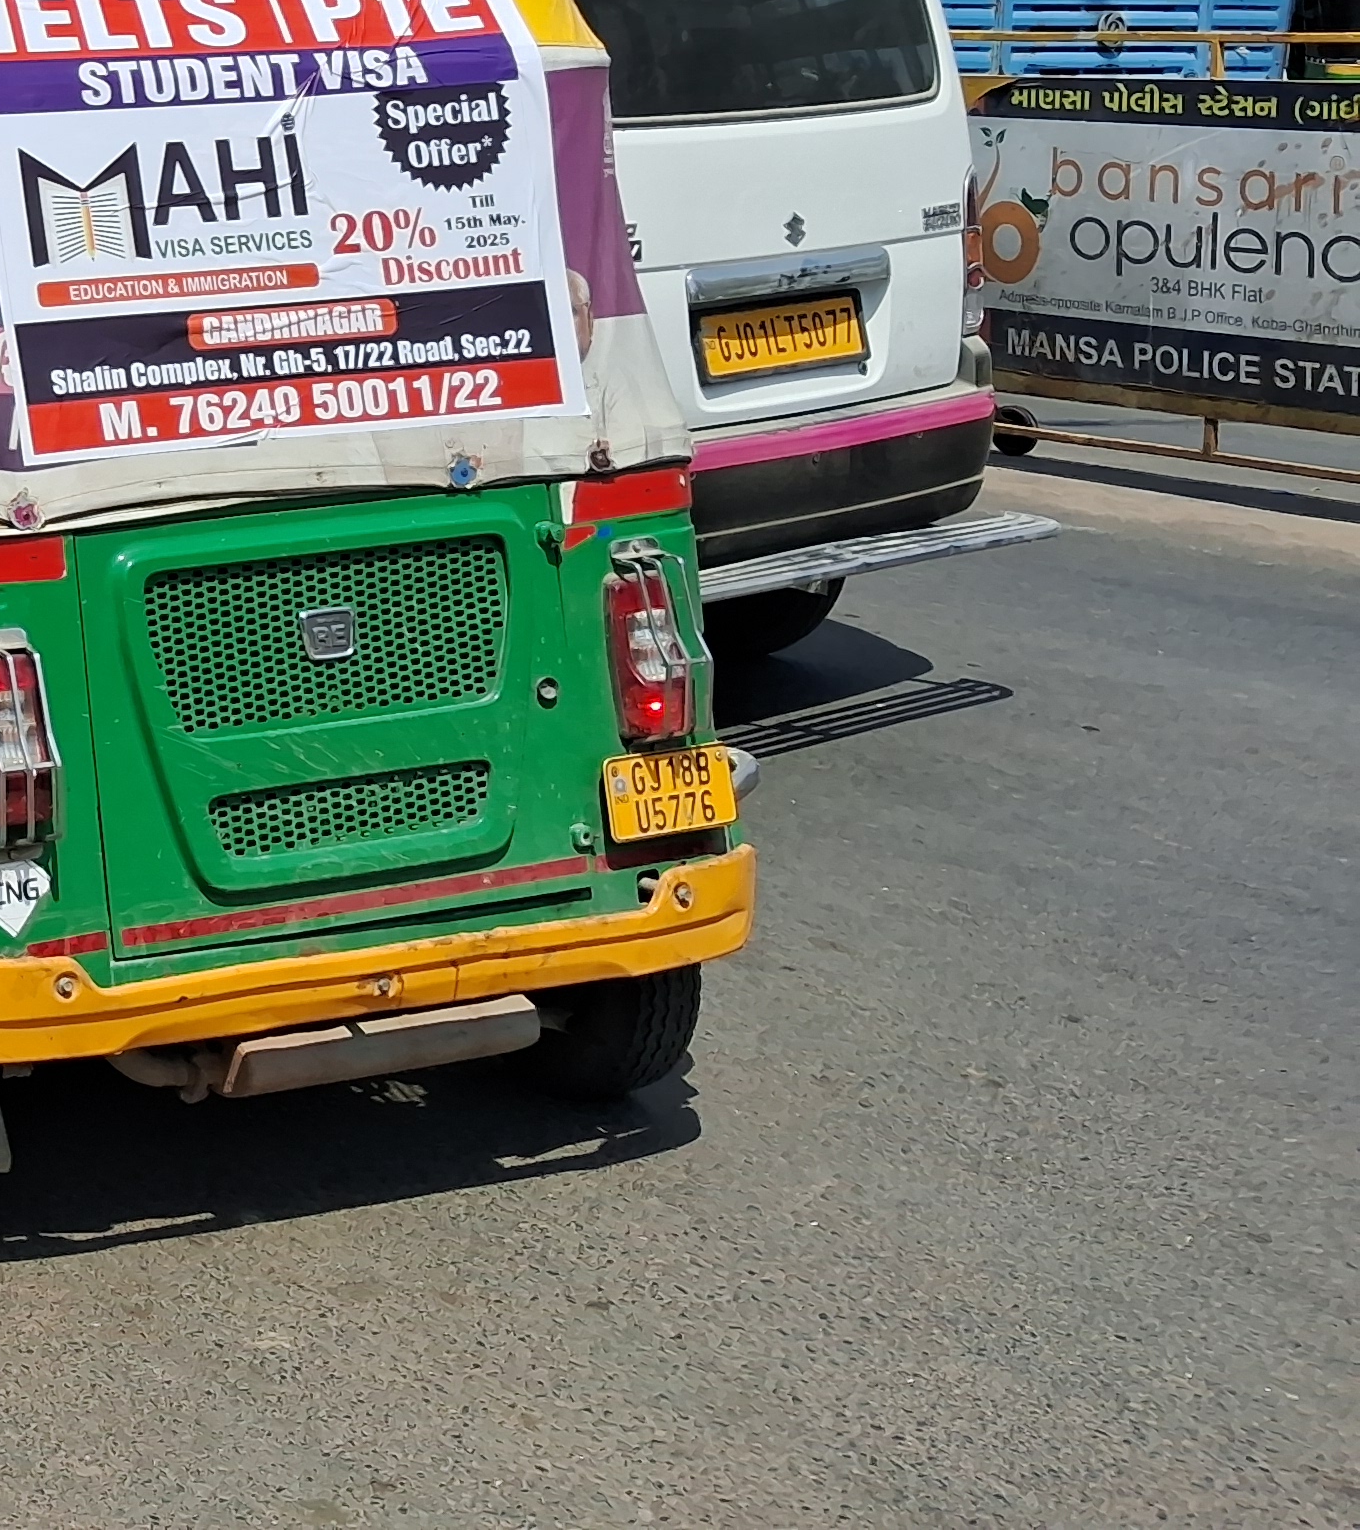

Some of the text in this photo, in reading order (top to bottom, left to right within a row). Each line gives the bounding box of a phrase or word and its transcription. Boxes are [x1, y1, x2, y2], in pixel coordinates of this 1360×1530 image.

[78, 45, 429, 106] STUDENT VISA
[385, 91, 500, 135] Special
[1010, 86, 1090, 111] માણસા
[1103, 82, 1183, 116] પોલીસ
[1197, 86, 1278, 119] સ્ટેસન
[468, 193, 496, 209] Till
[1052, 146, 1344, 216] bansari
[329, 206, 437, 255] 20%
[444, 213, 527, 231] 15th May.
[465, 232, 511, 249] 2025
[155, 229, 313, 259] VISA SERVICES
[69, 269, 288, 302] EDUCATION & IMMIGRATION
[381, 247, 524, 287] Discount
[1104, 300, 1164, 321] Kamalam
[1149, 276, 1266, 304] 3&4 BHK Flat
[202, 303, 385, 346] GANDHINAGAR
[50, 363, 128, 396] Shalin
[131, 355, 237, 389] Complex,
[239, 351, 271, 378] Nr.
[336, 341, 394, 370] 17/22
[398, 334, 460, 365] Road,
[460, 328, 533, 359] Sec.22
[1006, 326, 1125, 370] MANSA
[1132, 340, 1261, 386] POLICE
[98, 368, 503, 441] M. 76240 50011/22
[634, 789, 716, 834] U5776
